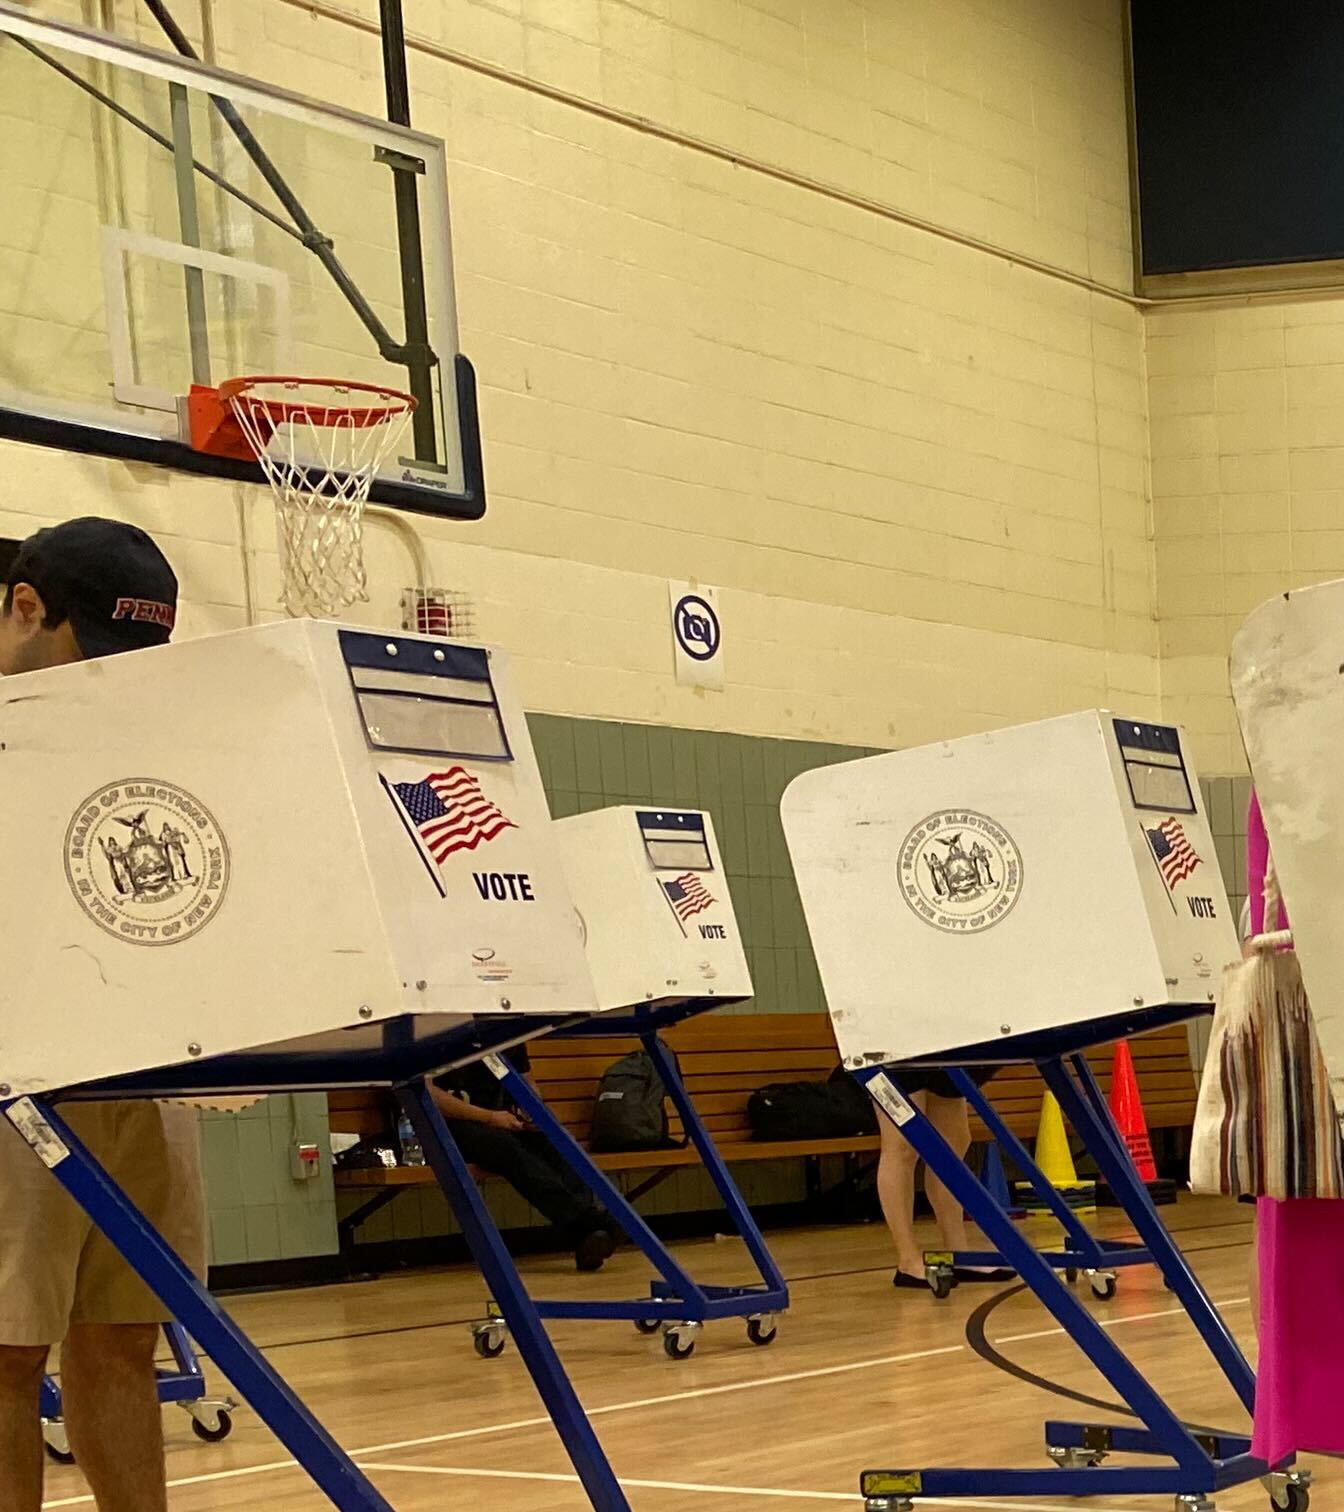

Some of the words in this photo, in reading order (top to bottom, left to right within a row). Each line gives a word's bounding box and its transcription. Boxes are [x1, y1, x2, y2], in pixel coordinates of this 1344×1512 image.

[472, 873, 535, 901] VOTE
[1186, 896, 1216, 918] VOTE
[698, 924, 727, 939] VOTE
